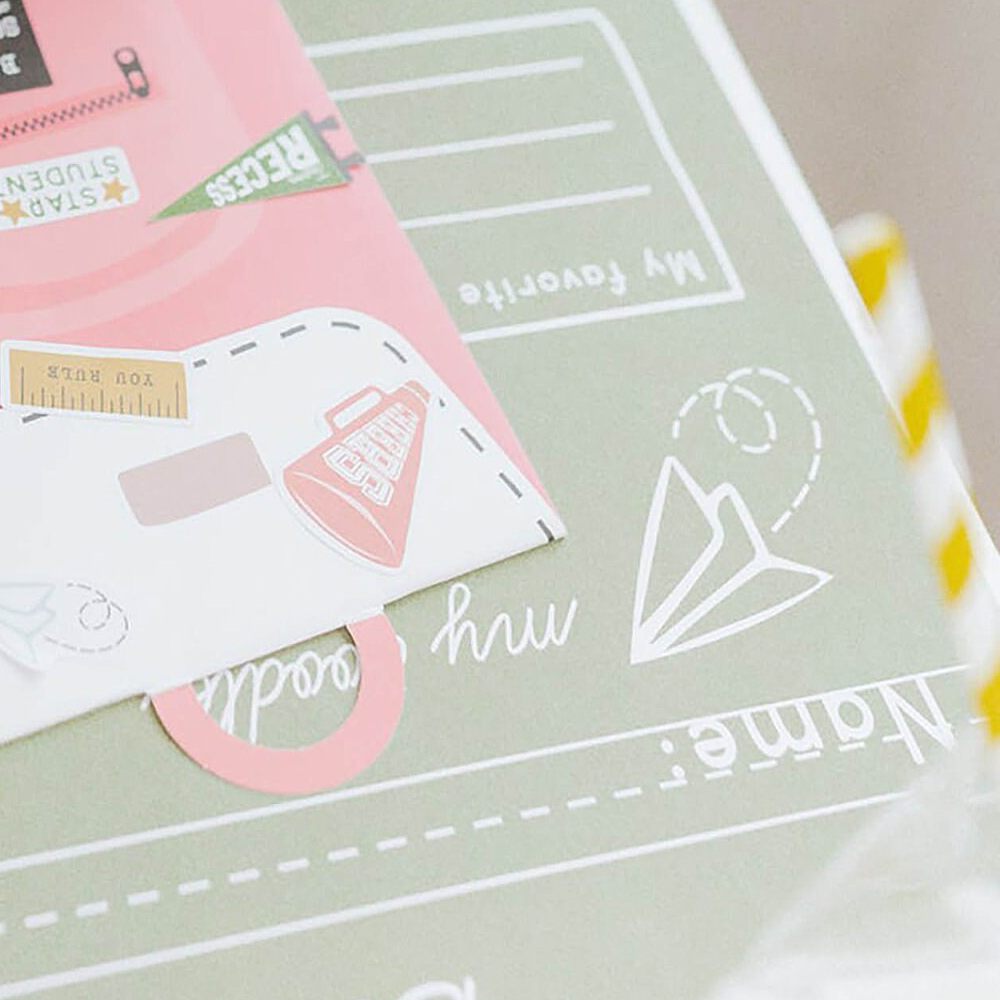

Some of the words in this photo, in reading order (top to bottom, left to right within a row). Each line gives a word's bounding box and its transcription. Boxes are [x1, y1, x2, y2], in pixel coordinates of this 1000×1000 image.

[205, 124, 320, 207] RECESS
[28, 187, 97, 218] STAR
[460, 260, 627, 313] favorite
[643, 247, 706, 286] My
[46, 364, 100, 383] RULE
[115, 370, 153, 387] YOU
[430, 582, 578, 665] my
[661, 677, 955, 778] Name:
